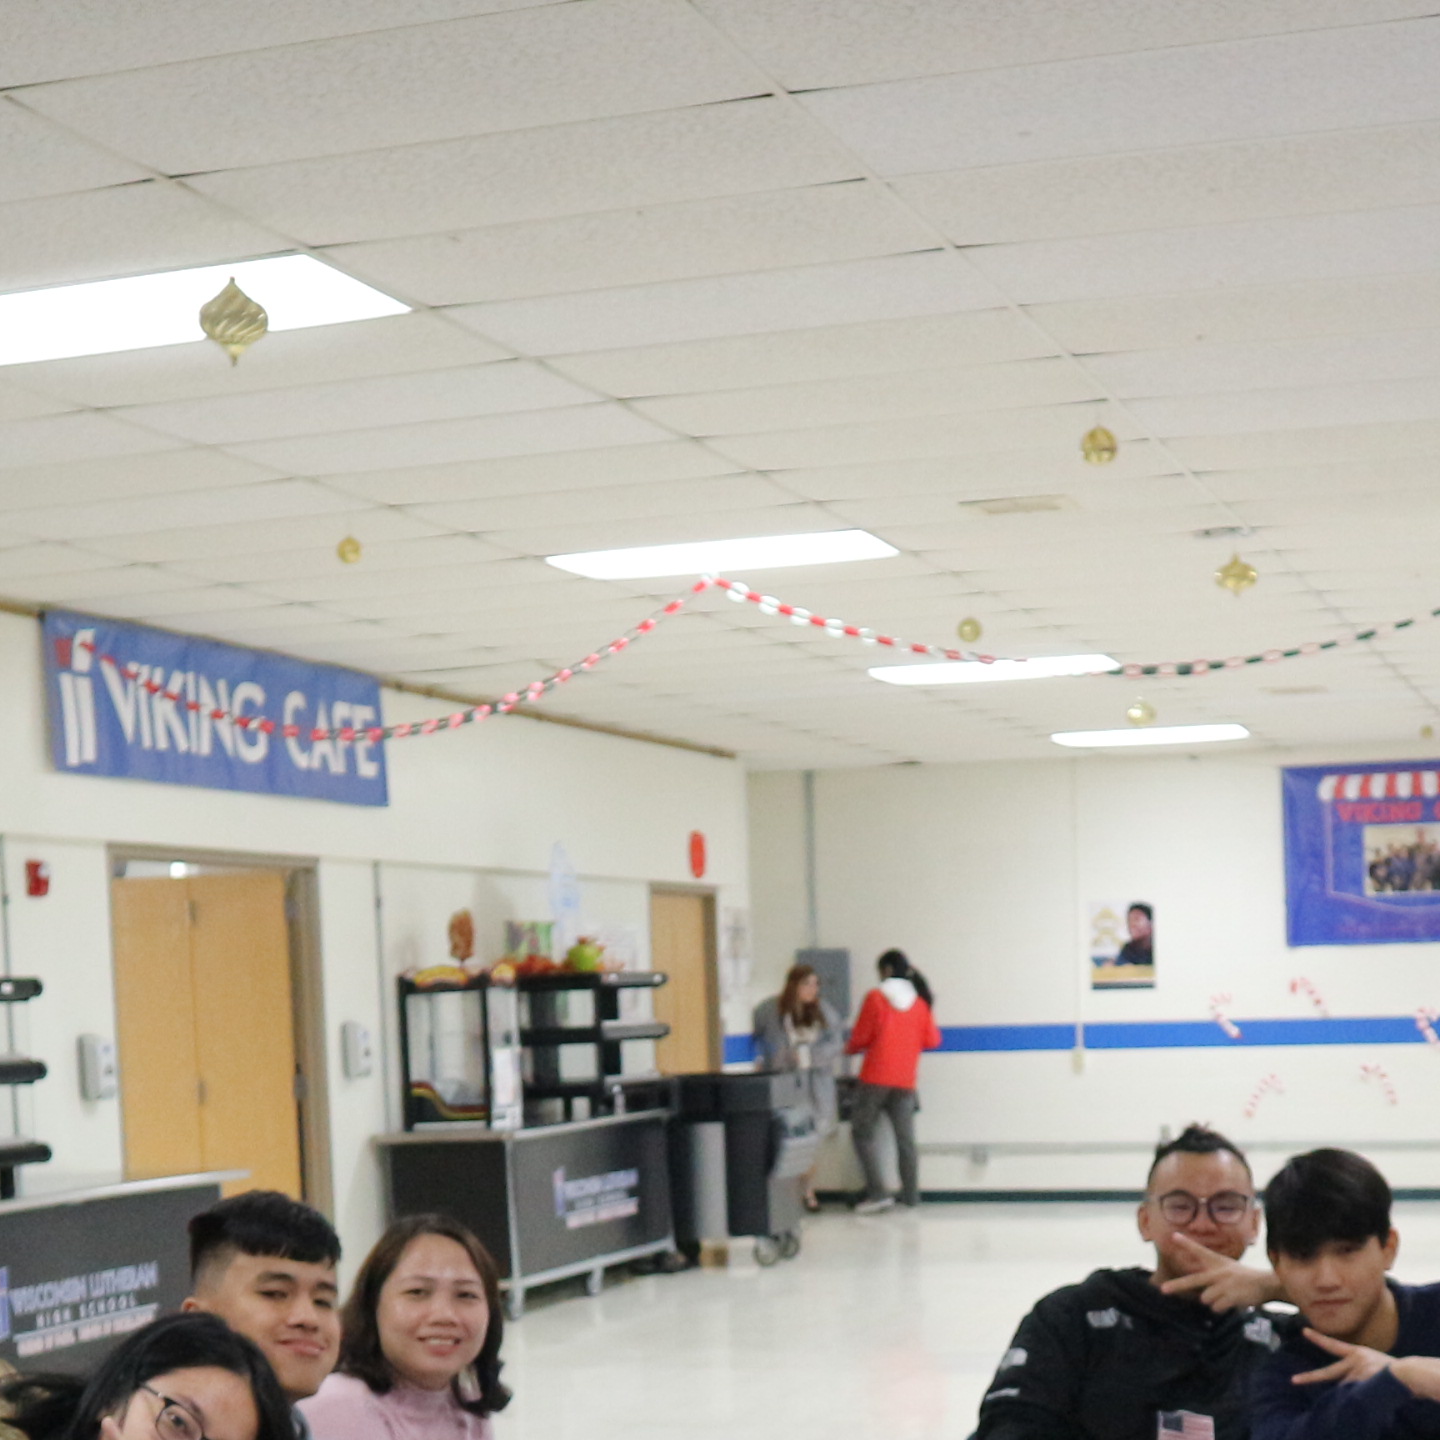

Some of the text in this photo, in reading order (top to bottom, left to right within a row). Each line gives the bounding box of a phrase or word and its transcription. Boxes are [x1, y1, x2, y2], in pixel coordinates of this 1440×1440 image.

[99, 659, 380, 779] VIKING CAFE
[1336, 801, 1423, 823] VIKING
